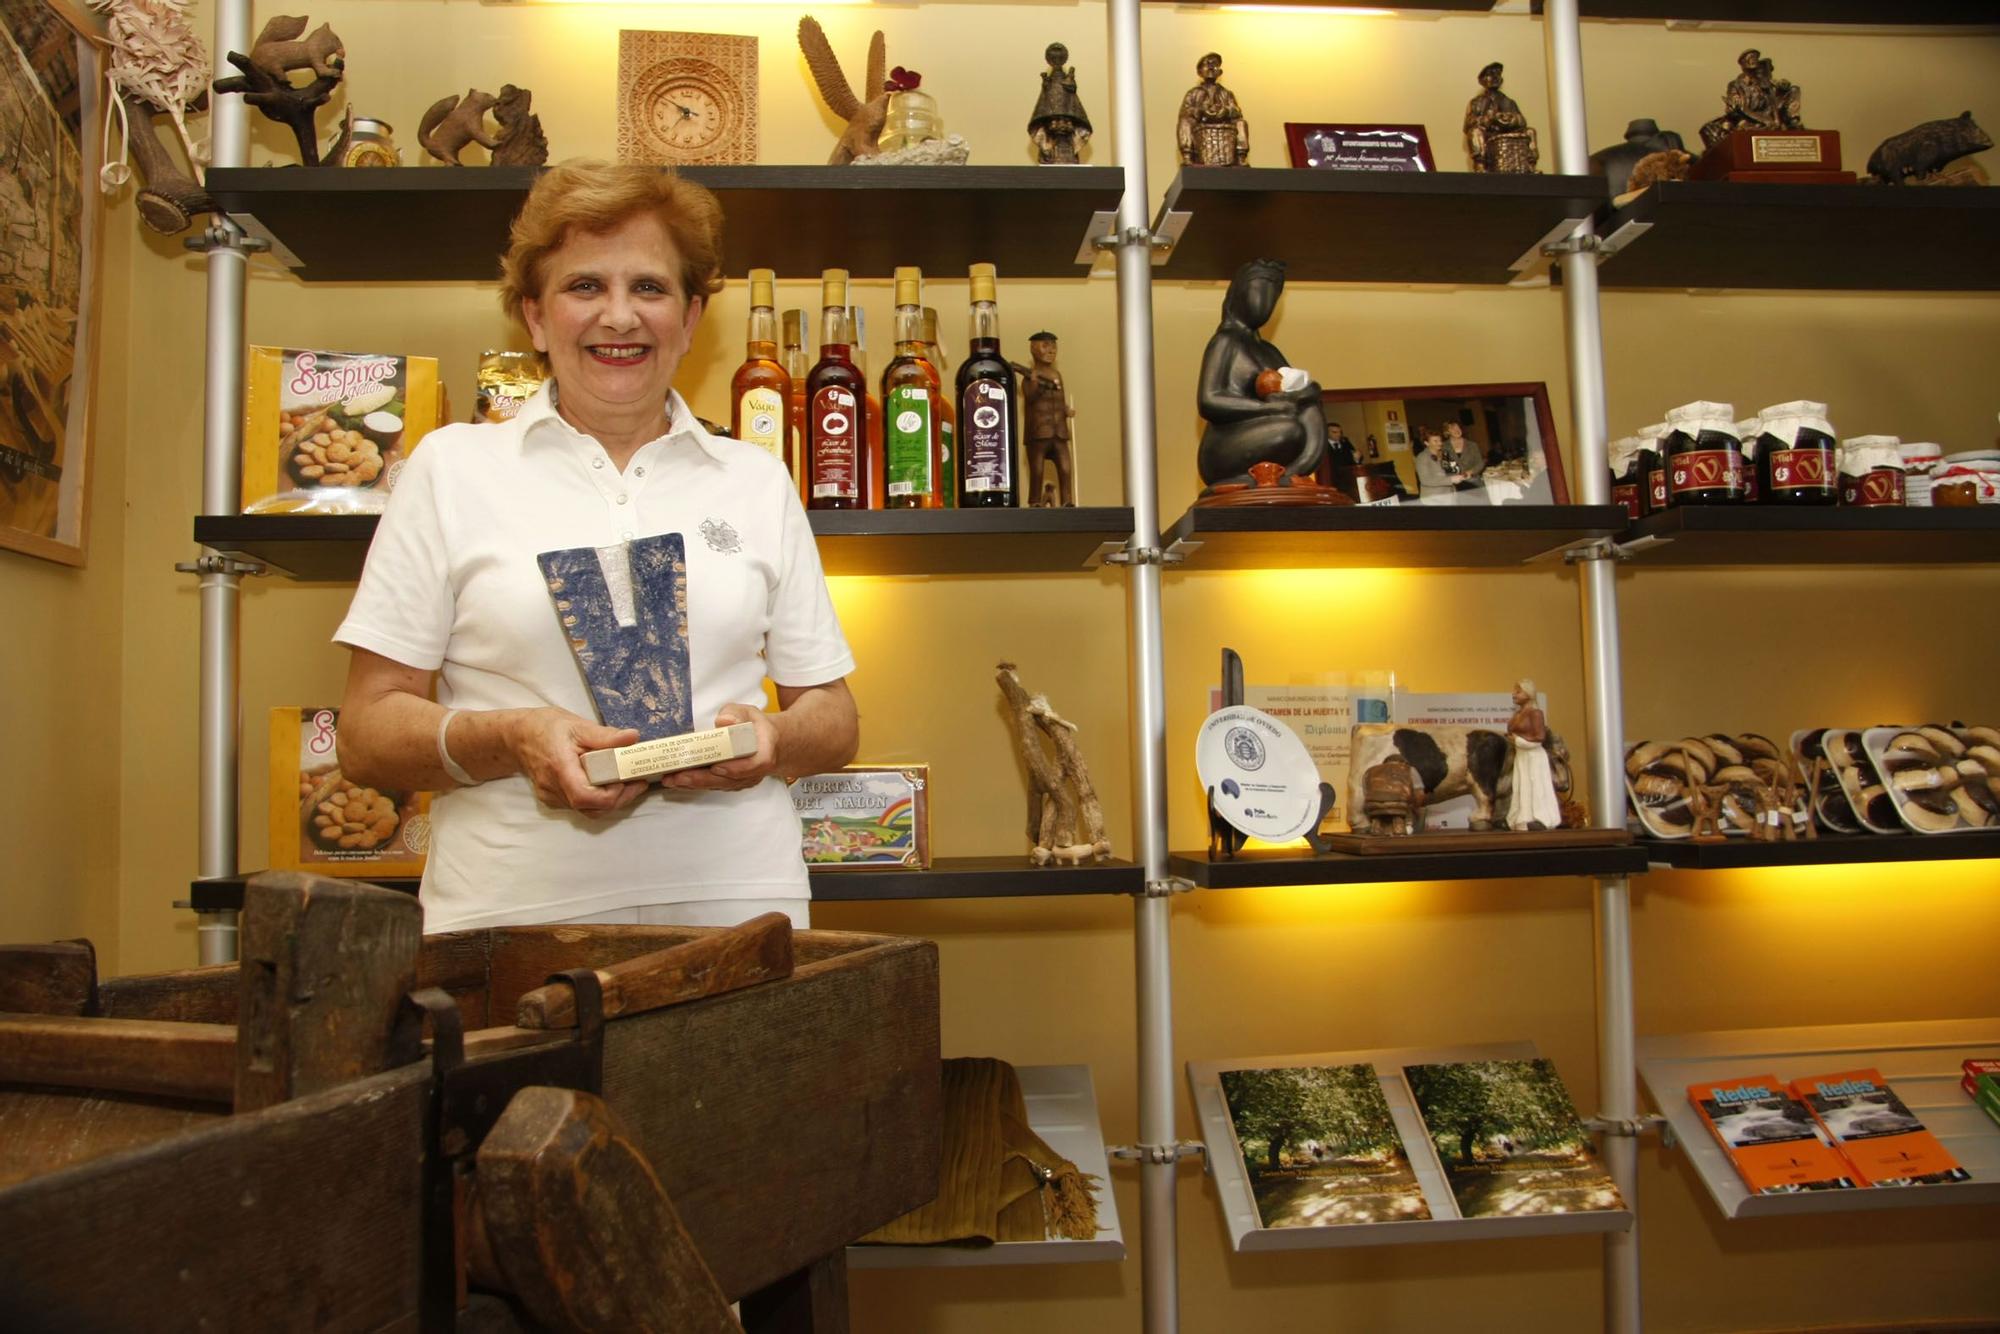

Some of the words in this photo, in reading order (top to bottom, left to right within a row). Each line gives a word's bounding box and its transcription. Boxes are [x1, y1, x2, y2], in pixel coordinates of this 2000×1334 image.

[290, 352, 399, 400] Suspiros
[1258, 708, 1291, 716] ERTAMEN
[1293, 708, 1302, 716] DE
[1303, 708, 1311, 716] LA
[1313, 708, 1339, 716] HUERTA
[801, 780, 863, 794] TORTAS
[792, 797, 825, 810] DEL
[1711, 1086, 1771, 1103] Redes
[1815, 1079, 1877, 1097] Redes
